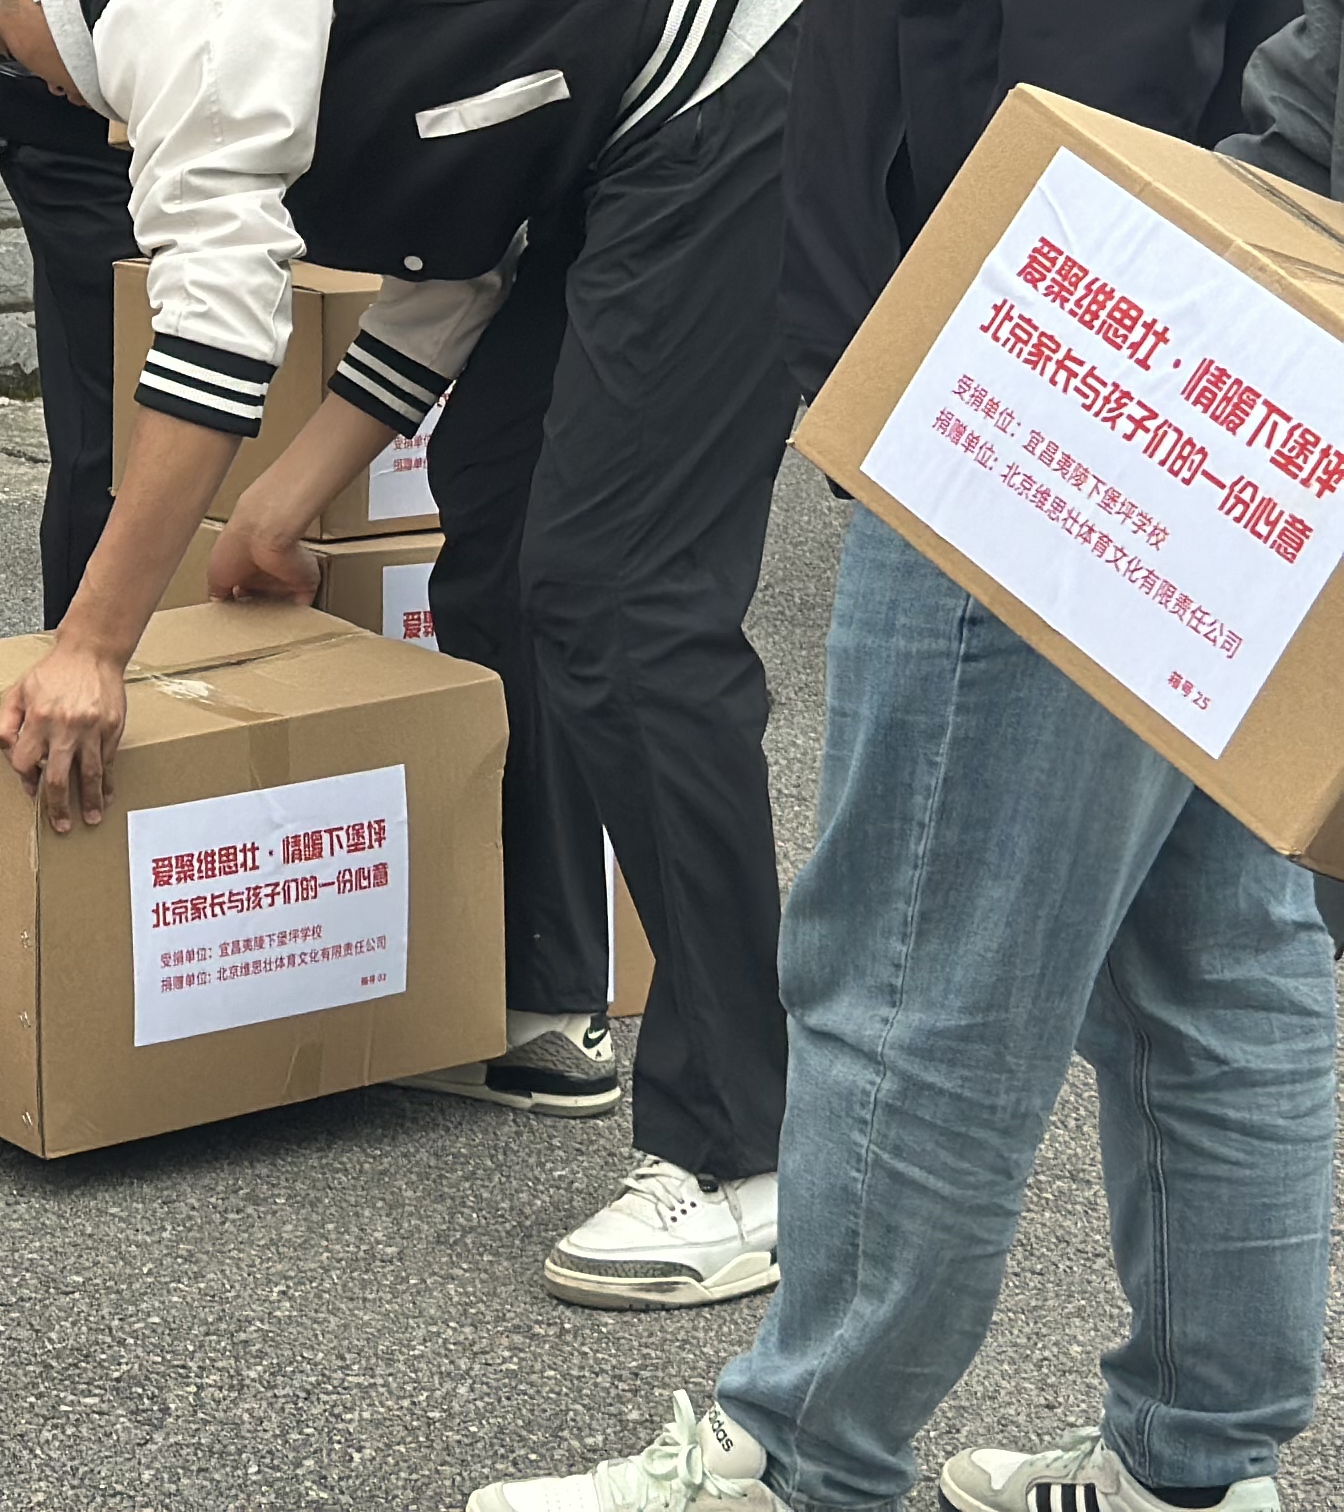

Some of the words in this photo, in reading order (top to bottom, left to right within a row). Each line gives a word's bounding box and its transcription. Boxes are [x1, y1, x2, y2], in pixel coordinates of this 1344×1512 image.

[979, 298, 1313, 564] 北京家长与孩子们的一份心意
[1192, 691, 1211, 710] 25
[152, 819, 386, 888] 爱聚维思壮·情暖下堡坪
[152, 863, 388, 928] 北京家长与孩子们的一份心意
